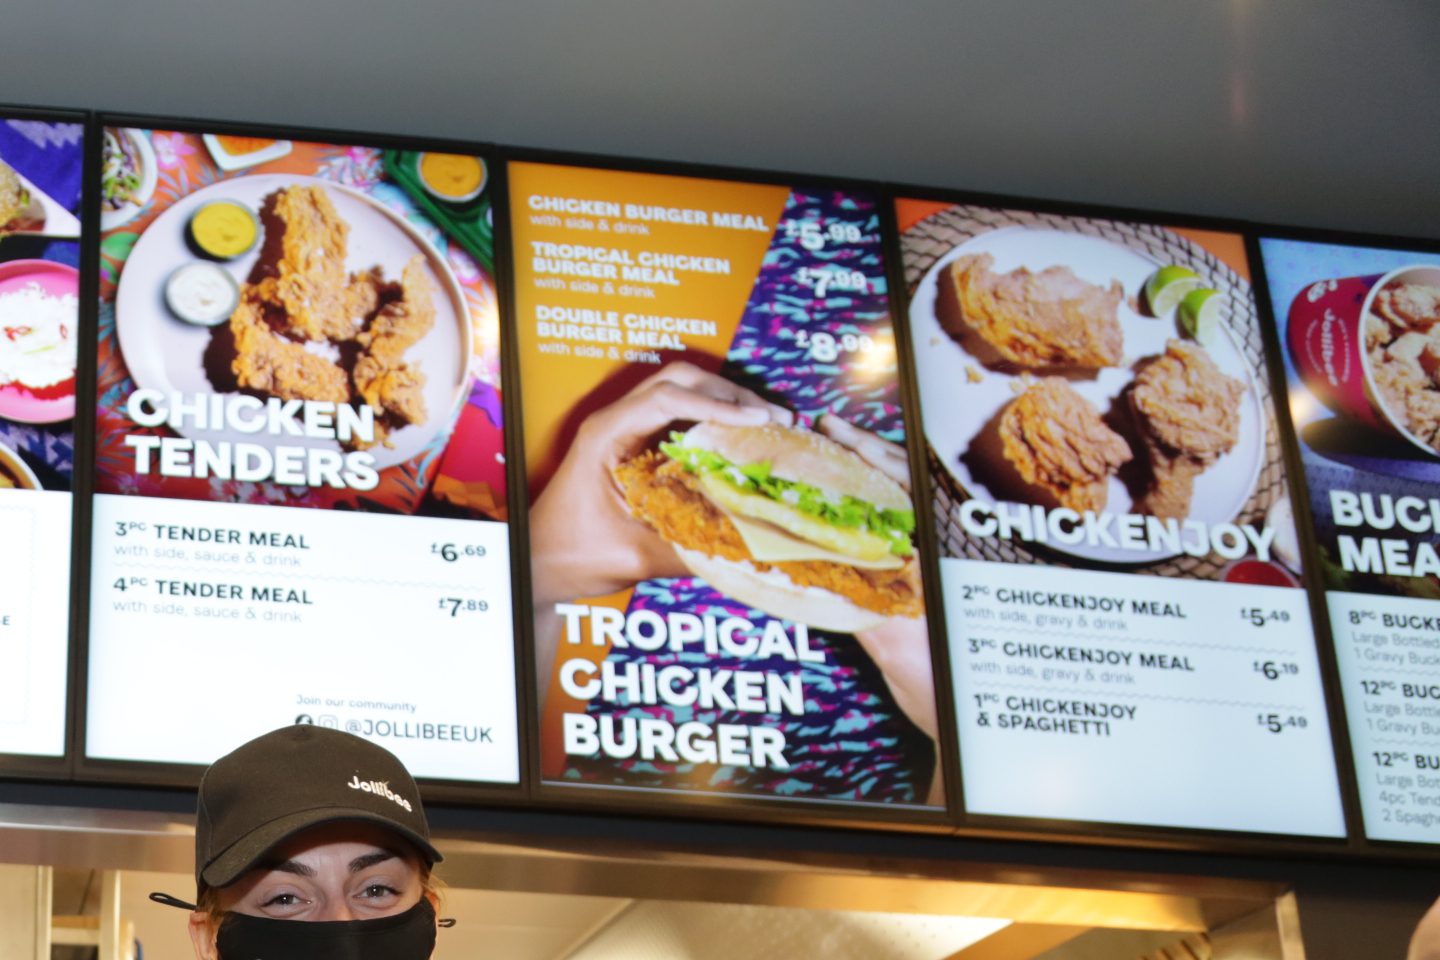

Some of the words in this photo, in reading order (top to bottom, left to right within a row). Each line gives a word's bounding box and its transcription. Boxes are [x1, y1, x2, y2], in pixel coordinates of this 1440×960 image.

[529, 195, 619, 216] CHICKEN
[626, 205, 707, 226] BURGER
[713, 213, 768, 231] MEAL
[529, 215, 561, 226] with
[565, 217, 594, 230] side
[531, 242, 633, 264] TROPICAL
[639, 252, 729, 273] CHICKEN
[533, 258, 616, 278] BURGER
[624, 267, 679, 285] MEAL
[534, 278, 566, 289] with
[570, 280, 598, 293] side
[619, 284, 655, 298] drink
[536, 306, 618, 326] DOUBLE
[624, 314, 716, 335] CHICKEN
[538, 323, 622, 343] BURGER
[628, 332, 685, 350] MEAL
[538, 343, 570, 355] with
[575, 345, 604, 358] side
[624, 349, 661, 364] drink
[126, 389, 374, 441] CHICKEN
[125, 436, 379, 490] TENDERS
[154, 525, 241, 543] TENDER
[249, 531, 311, 550] MEAL
[961, 500, 1276, 561] CHICKENJOY
[114, 544, 148, 557] with
[154, 546, 189, 561] side,
[195, 551, 240, 563] sauce
[245, 552, 257, 565] &
[263, 553, 302, 567] drink
[156, 580, 243, 599] TENDER
[251, 587, 314, 605] MEAL
[997, 589, 1124, 612] CHICKENJOY
[1132, 600, 1187, 618] MEAL
[113, 600, 147, 612] with
[153, 602, 189, 617] side,
[194, 606, 240, 619] sauce
[245, 607, 257, 620] &
[263, 608, 302, 623] drink
[964, 607, 995, 619] with
[1036, 613, 1073, 629] gravy
[1078, 615, 1088, 627] &
[1093, 616, 1128, 631] drink
[556, 603, 824, 662] TROPICAL
[1352, 632, 1388, 647] Large
[1004, 642, 1132, 666] CHICKENJOY
[1140, 653, 1195, 672] MEAL
[1364, 648, 1404, 665] Gravy
[970, 660, 1001, 674] with
[1042, 667, 1080, 683] gravy
[1085, 669, 1095, 681] &
[1100, 670, 1136, 685] drink
[561, 658, 803, 715] CHICKEN
[296, 695, 321, 706] Join
[325, 698, 344, 707] our
[349, 700, 417, 714] community
[1007, 697, 1137, 720] CHICKENJOY
[1363, 701, 1401, 717] Large
[346, 719, 492, 742] @JOLLIBEEUK
[977, 712, 990, 727] &
[999, 715, 1110, 736] SPAGHETTI
[1376, 719, 1417, 736] Gravy
[564, 713, 788, 767] BURGER
[348, 776, 411, 812] Jollibee
